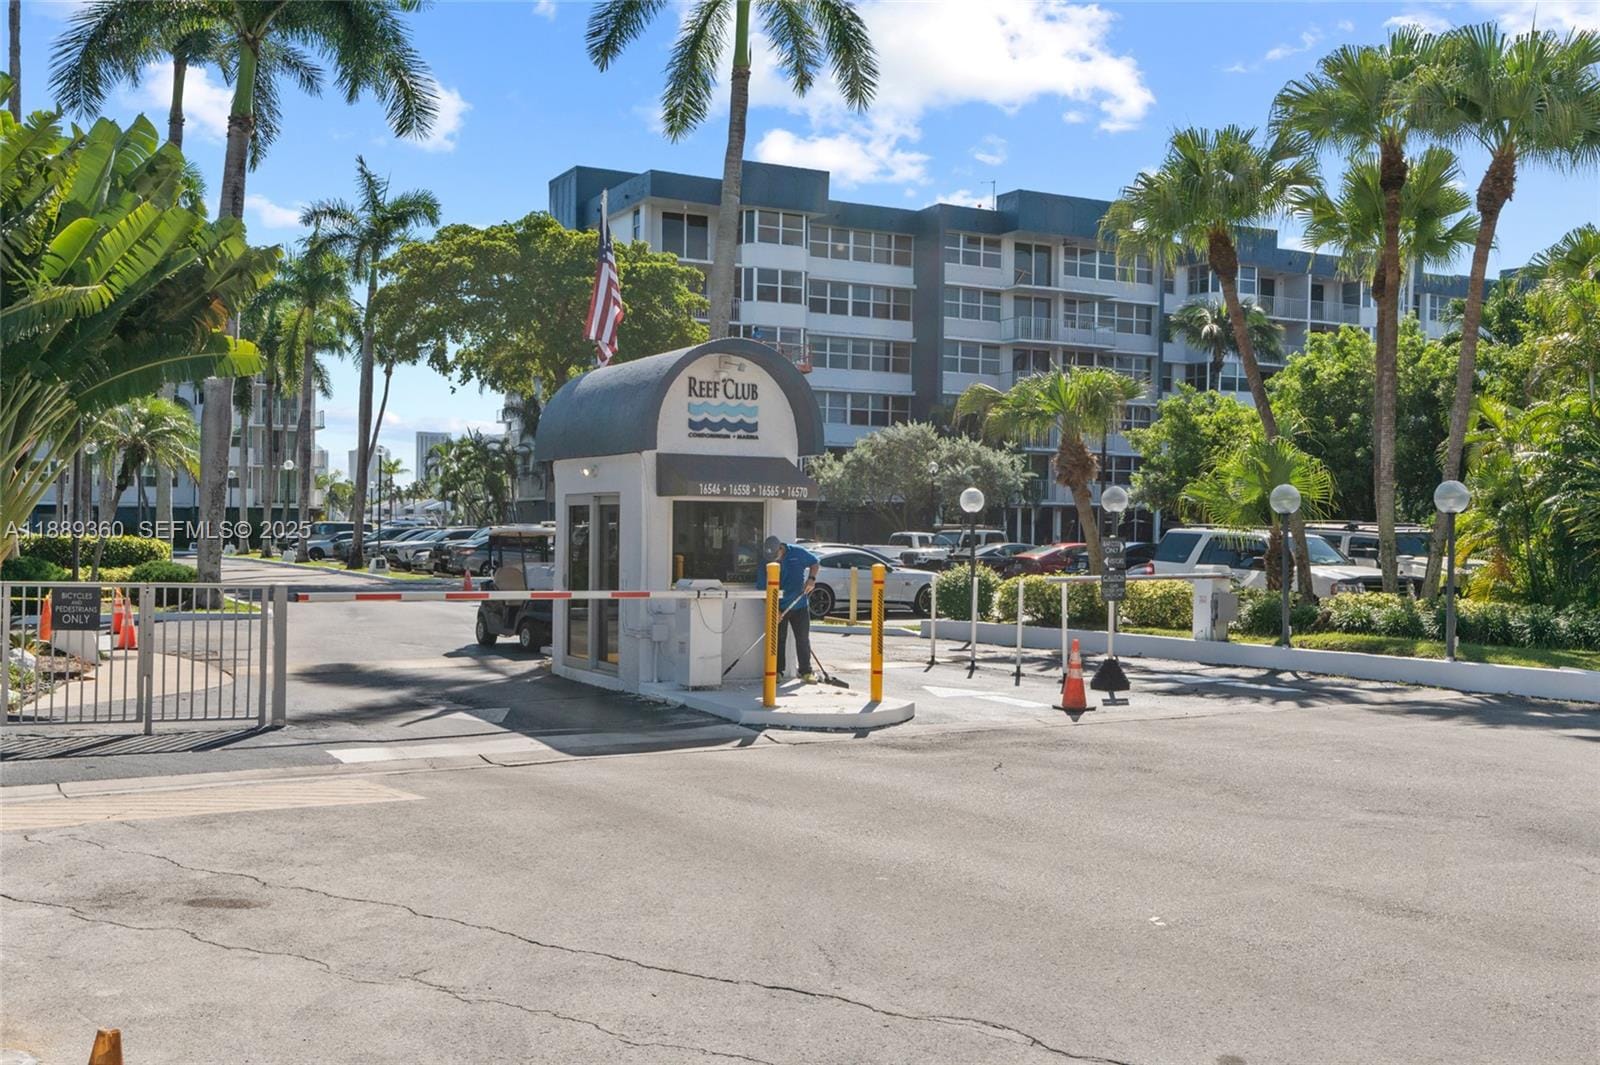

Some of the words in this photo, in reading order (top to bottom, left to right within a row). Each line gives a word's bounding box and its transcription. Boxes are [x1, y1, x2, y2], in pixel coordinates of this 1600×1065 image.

[688, 376, 720, 398] REEF
[699, 483, 721, 495] 16546
[729, 484, 751, 496] 16558
[758, 485, 780, 497] 16565
[787, 486, 808, 498] 16570
[61, 592, 93, 600] BICYCLES
[55, 605, 98, 613] PEDESTRIANS
[62, 614, 90, 624] ONLY
